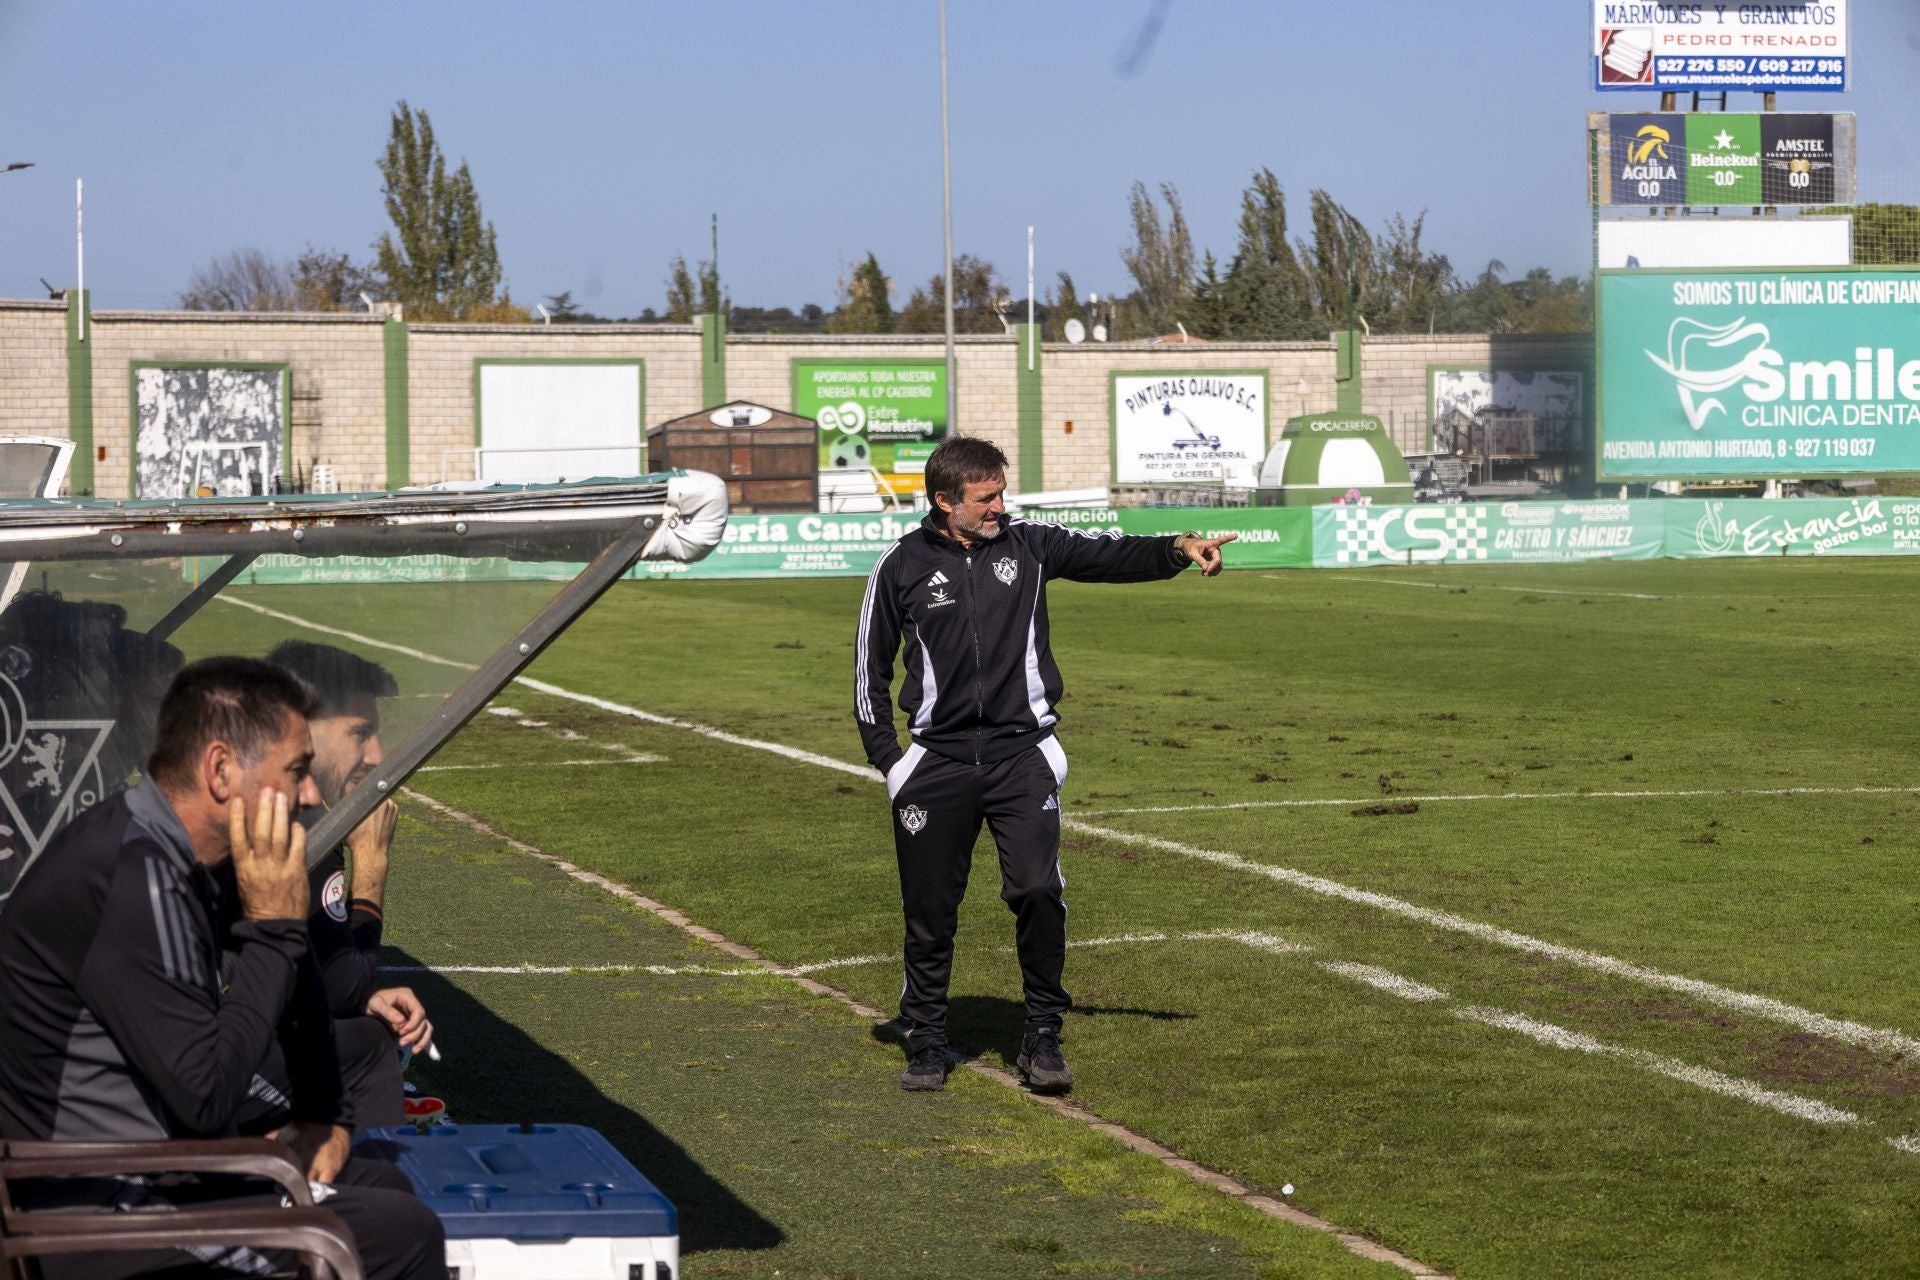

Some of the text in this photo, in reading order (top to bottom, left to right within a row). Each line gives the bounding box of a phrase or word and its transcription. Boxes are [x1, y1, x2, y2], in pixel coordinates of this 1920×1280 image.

[1605, 2, 1836, 25] MÁRMOLES Y GRANITOS
[1664, 35, 1837, 46] PEDRO TRENADO
[1657, 59, 1685, 72] 927
[1687, 59, 1714, 72] 276
[1717, 59, 1746, 72] 550
[1759, 59, 1789, 72] 609
[1791, 59, 1816, 72] 217
[1818, 59, 1842, 72] 916
[1657, 74, 1842, 86] www.marmolespedrotrenado.es
[1776, 139, 1824, 151] AMSTEL
[1691, 153, 1758, 167] Heineken
[1673, 281, 1732, 305] SOMOS
[1735, 281, 1757, 305] TU
[1760, 276, 1824, 304] CLÍNICA
[1827, 280, 1848, 304] DE
[870, 371, 895, 382] TODA
[896, 371, 937, 382] NUESTRA
[1125, 379, 1185, 414] PINTURAS
[1189, 378, 1234, 400] OJALVO
[1742, 404, 1838, 426] CLINICA
[867, 418, 933, 436] Marketing
[1603, 438, 1876, 459] AVENIDA ANTONIO HURTADO, 8 927 119 037
[1029, 508, 1118, 523] fundación
[1375, 508, 1449, 561] CS
[1494, 524, 1633, 549] CASTRO Y SÁNCHEZ
[1742, 500, 1884, 555] Estancia
[1814, 521, 1888, 553] gastro bar
[927, 599, 955, 609] Extremadura
